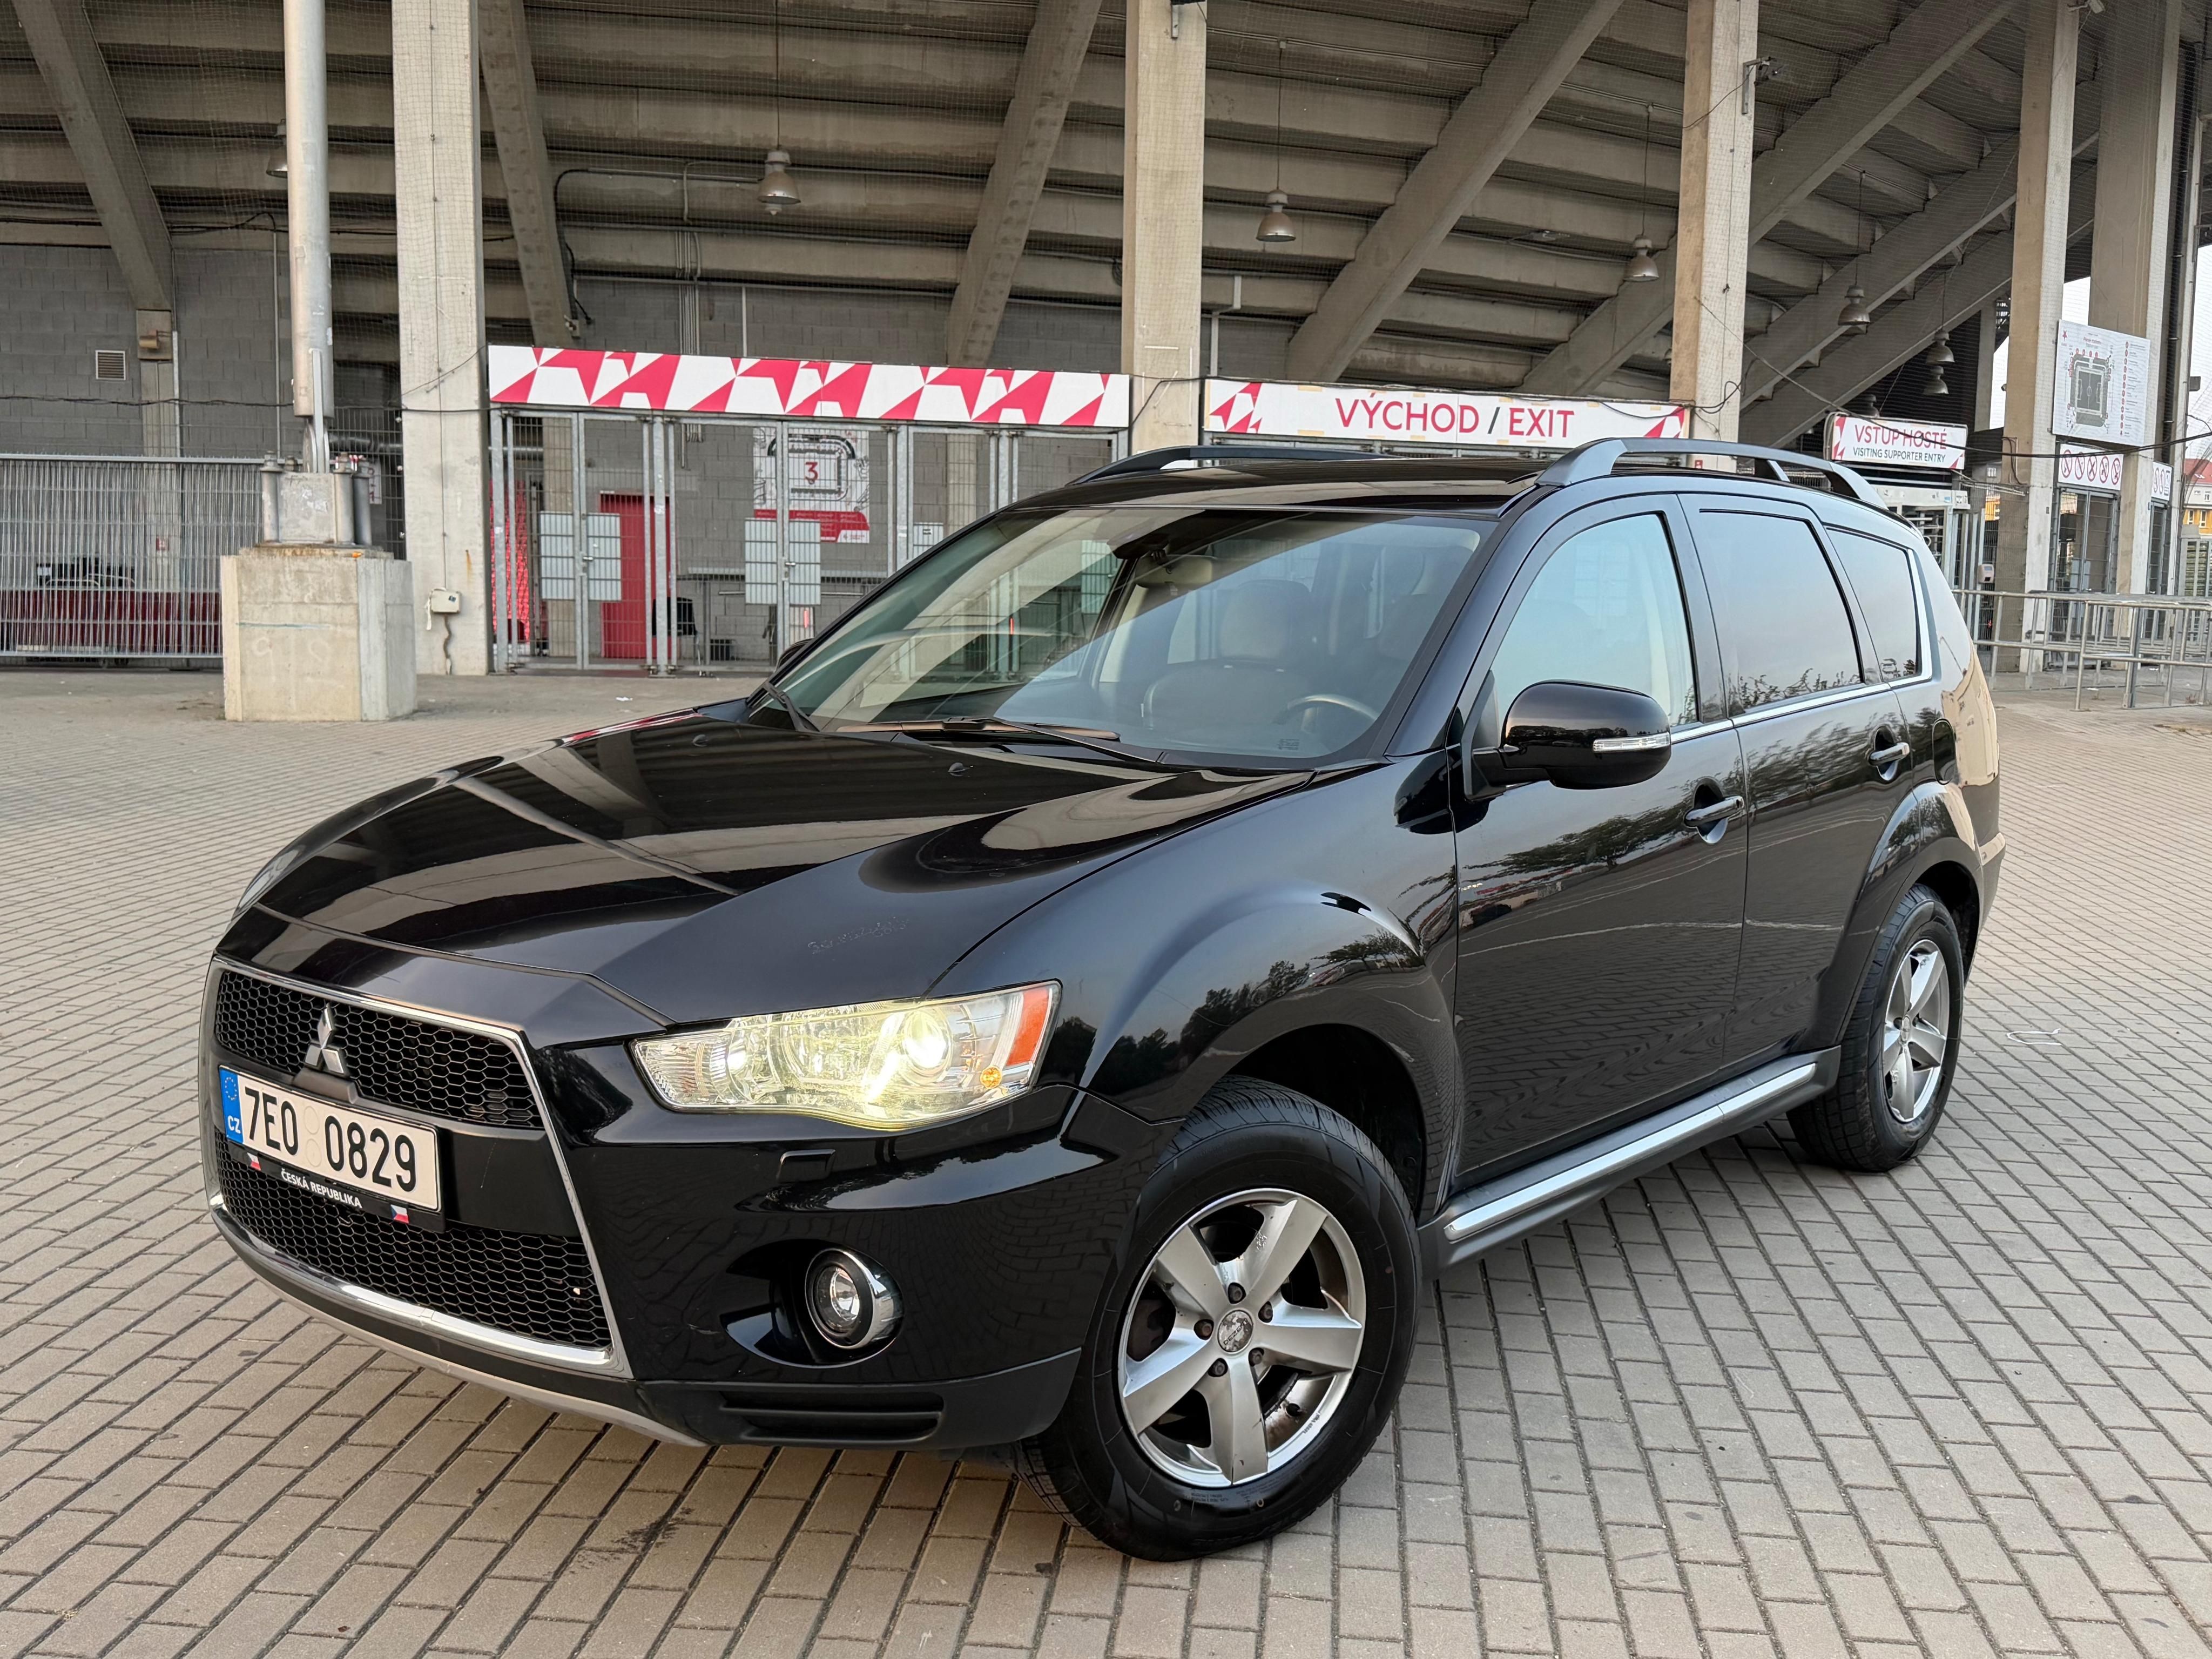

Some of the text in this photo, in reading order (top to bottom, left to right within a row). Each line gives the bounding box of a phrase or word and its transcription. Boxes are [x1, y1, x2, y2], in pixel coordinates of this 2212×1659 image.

[1335, 393, 1575, 437] VÝCHOD / EXIT
[1854, 424, 1947, 450] VSTUP HOSTÉ
[1853, 447, 1946, 463] VISITING SUPPORTER ENTRY
[805, 461, 819, 485] 3
[227, 1115, 241, 1134] CZ
[324, 1115, 416, 1192] 0829
[281, 1168, 363, 1209] ČESKÁ REPUBLIKA
